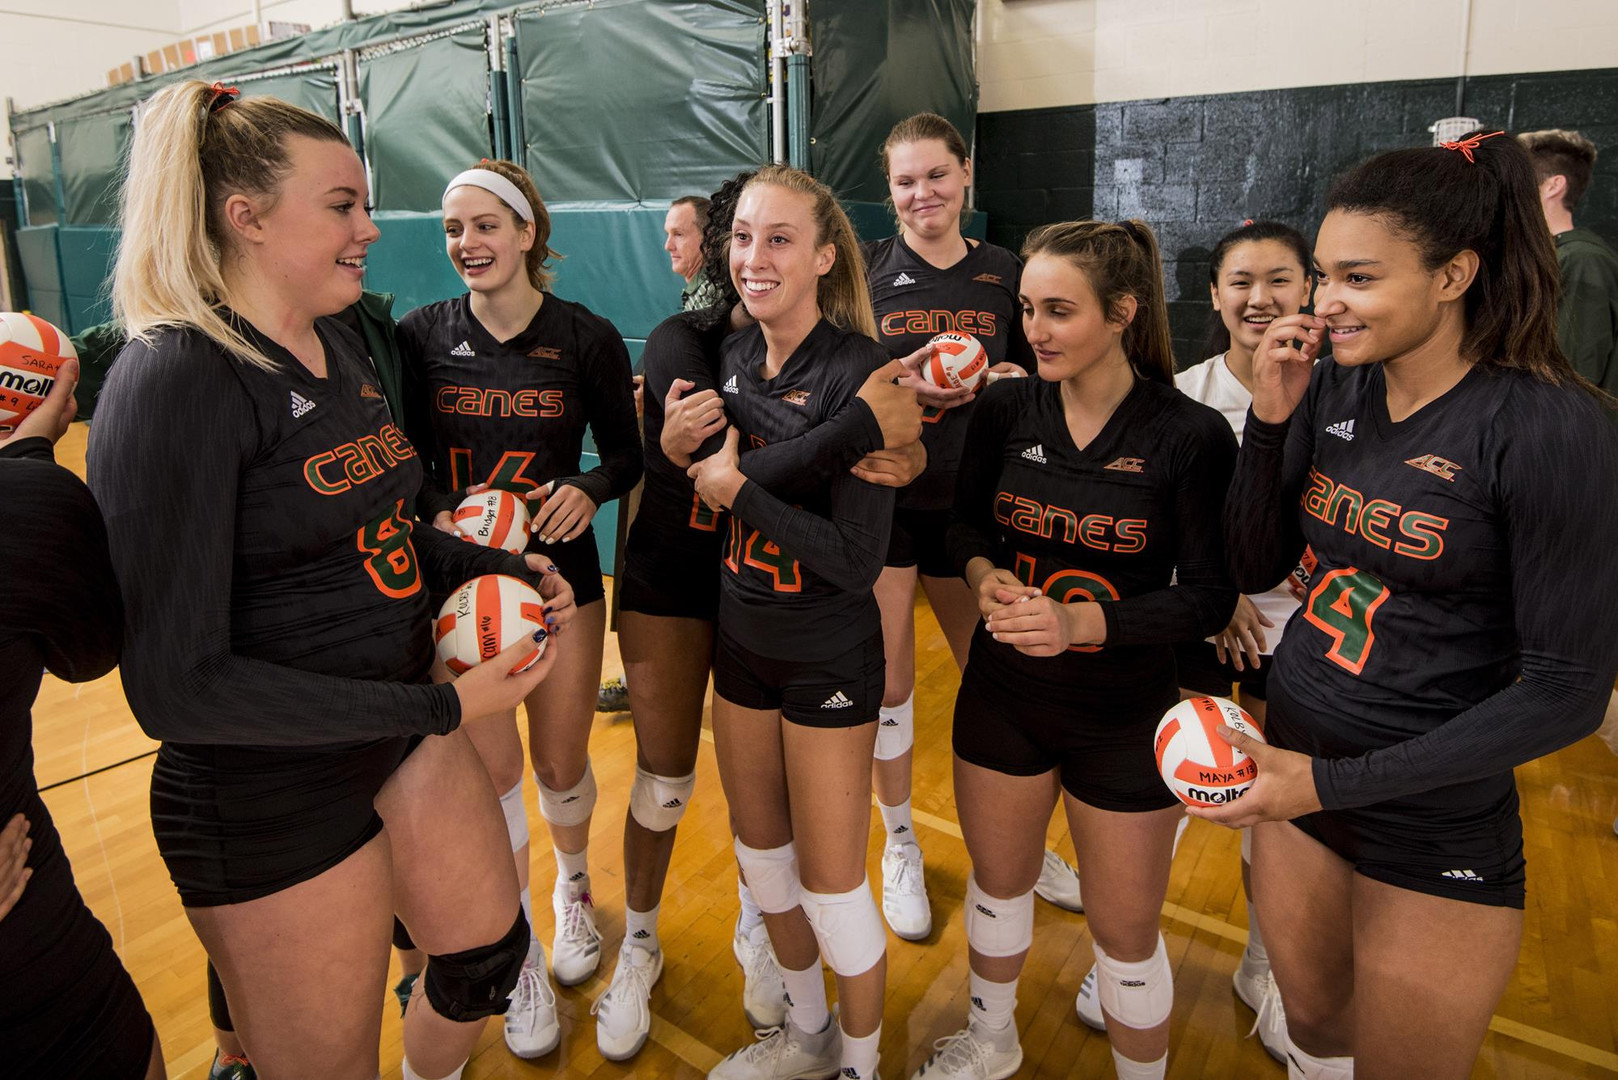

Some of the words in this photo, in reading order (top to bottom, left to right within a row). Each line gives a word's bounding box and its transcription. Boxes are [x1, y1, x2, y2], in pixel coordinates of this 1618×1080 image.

[1325, 425, 1355, 442] adidas
[1021, 451, 1048, 465] adidas
[356, 498, 422, 599] 8
[1303, 565, 1391, 676] 4
[1199, 771, 1235, 784] MAYA
[1235, 764, 1255, 779] #13
